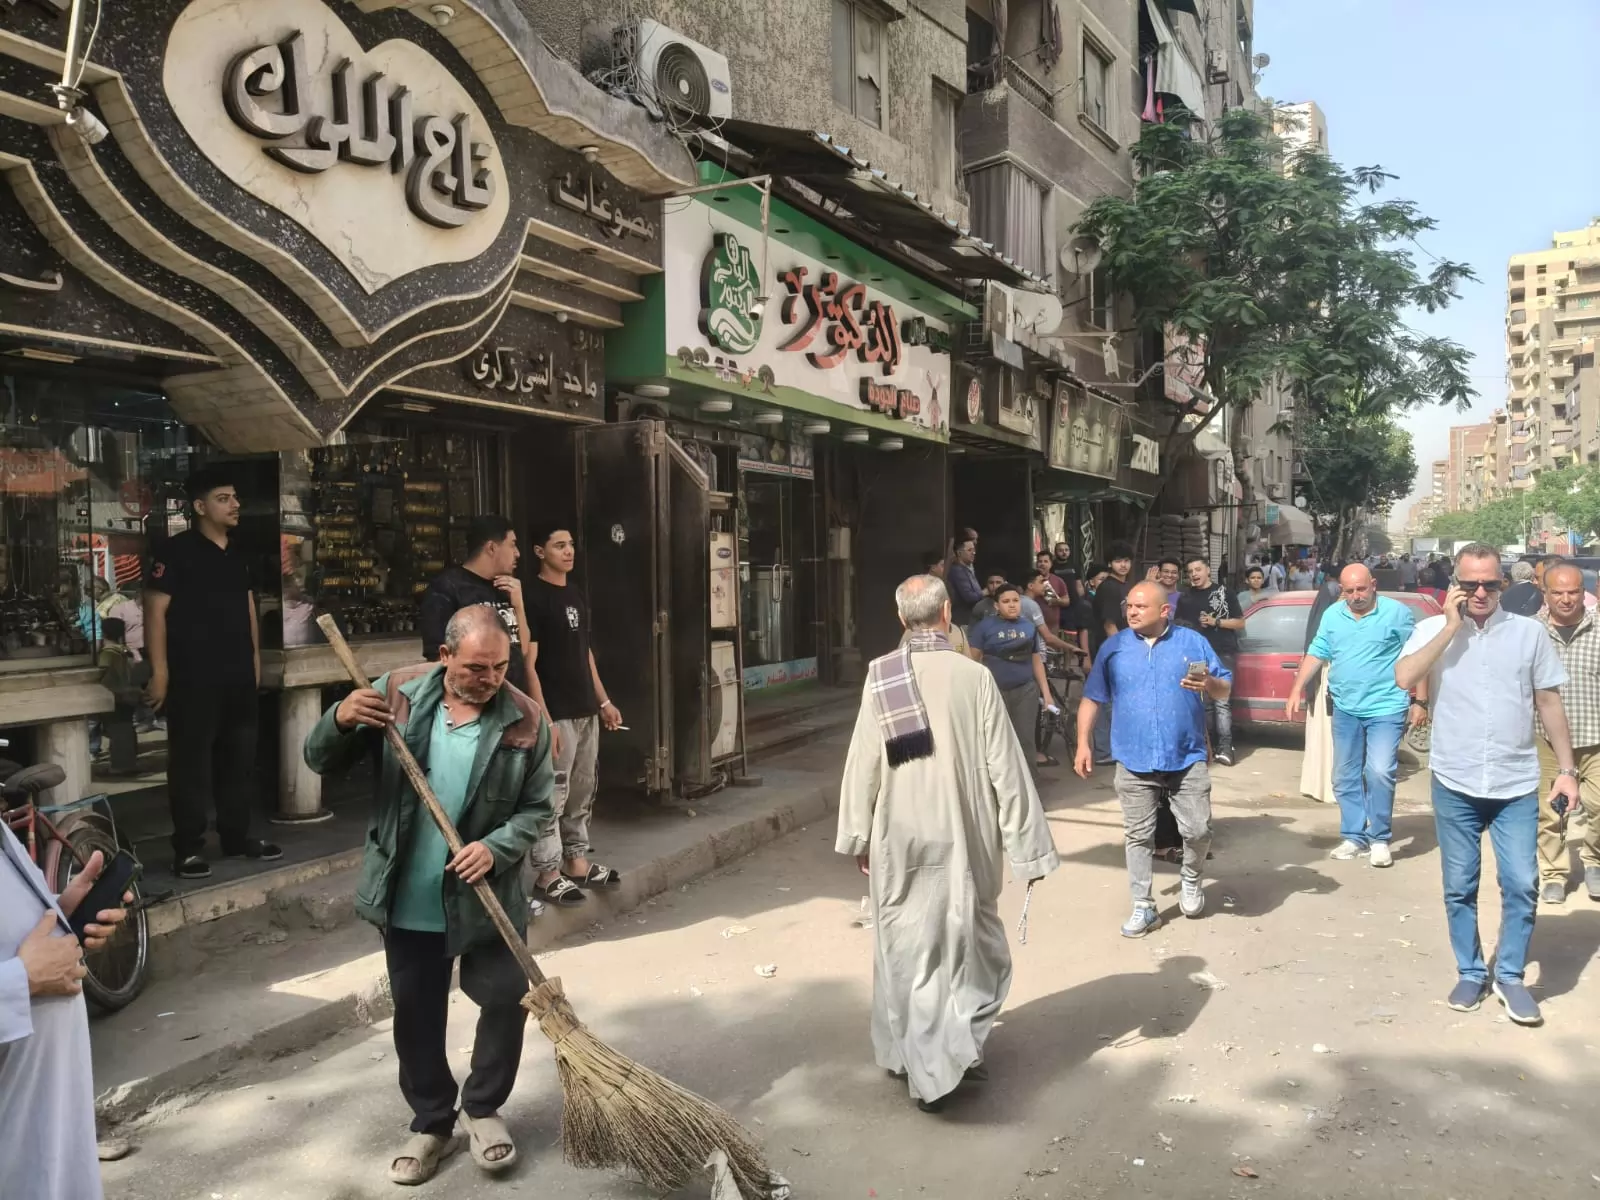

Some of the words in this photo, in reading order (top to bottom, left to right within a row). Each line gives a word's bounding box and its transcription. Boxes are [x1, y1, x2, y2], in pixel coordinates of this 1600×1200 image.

[222, 29, 413, 174] الملوك
[406, 112, 496, 229] تاج
[559, 171, 654, 239] مصوغات
[563, 358, 597, 407] ماجد
[1130, 433, 1160, 475] ZEKA
